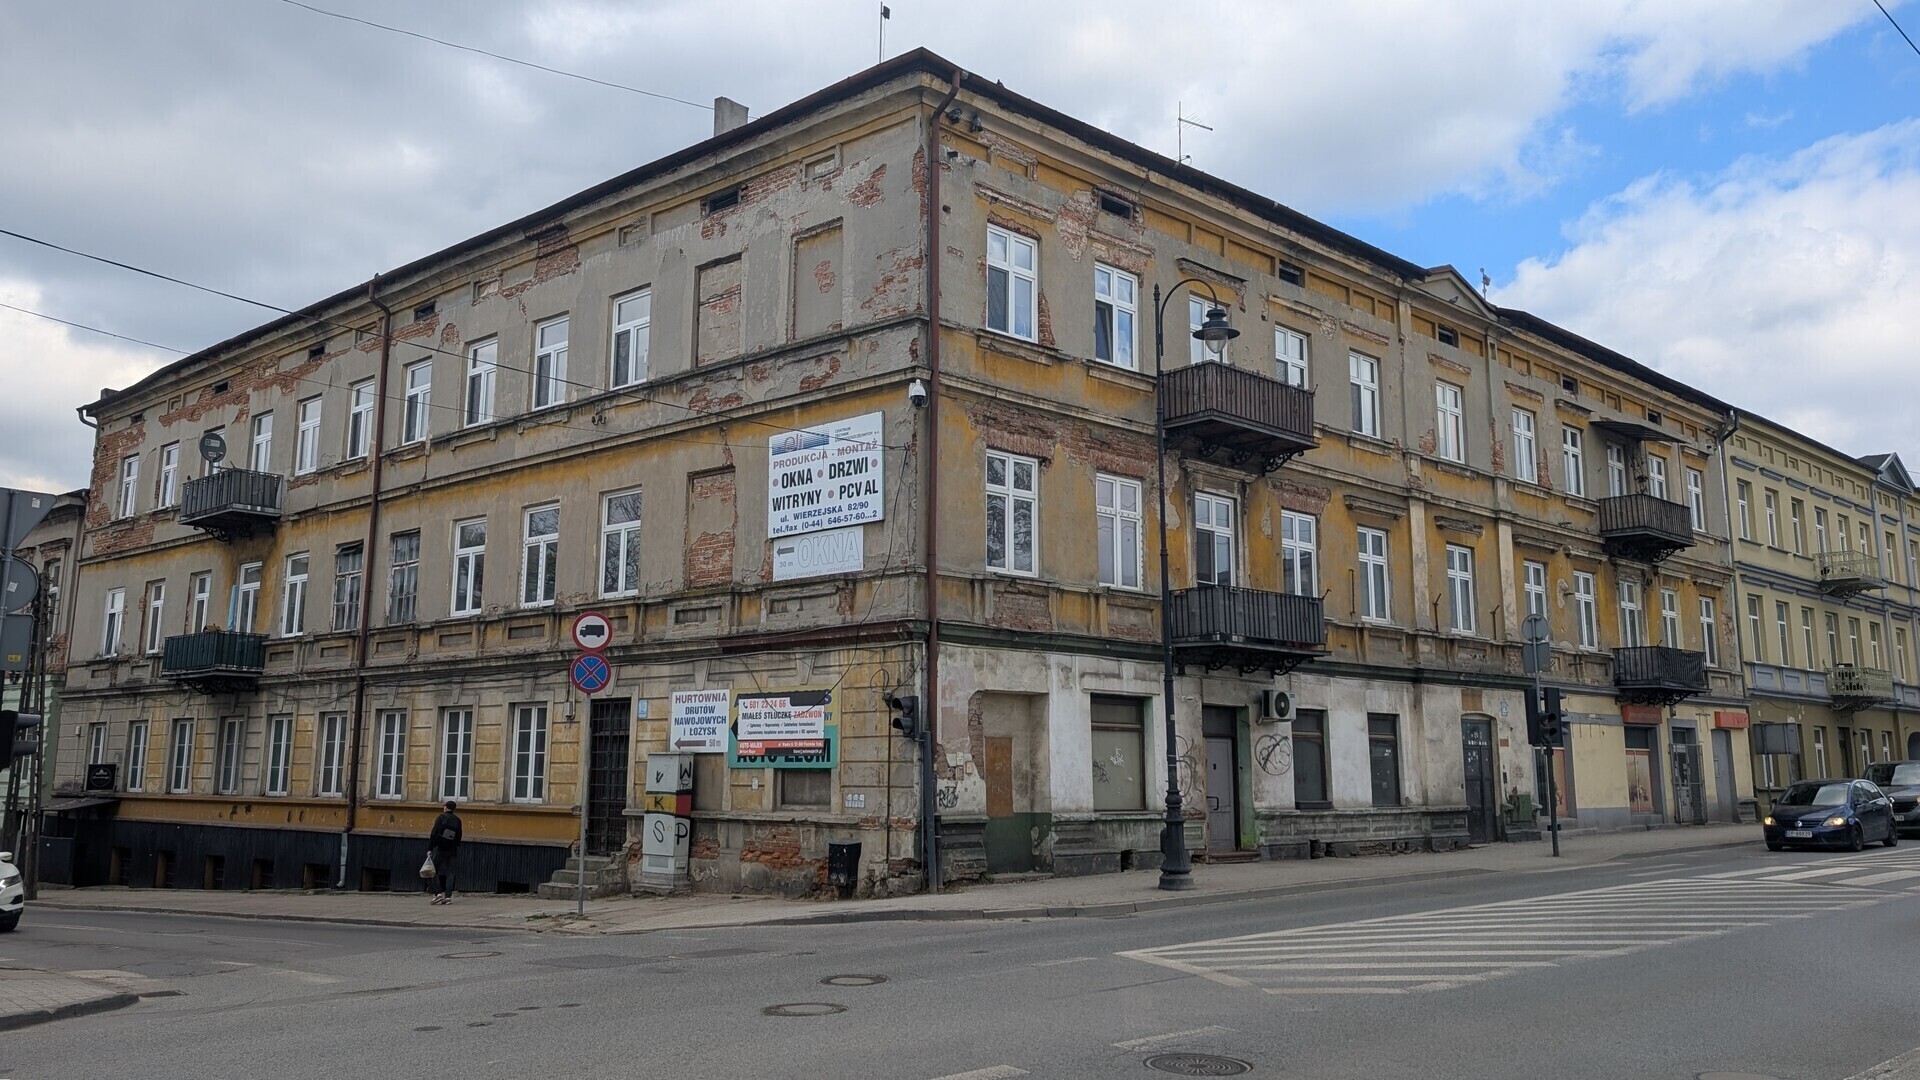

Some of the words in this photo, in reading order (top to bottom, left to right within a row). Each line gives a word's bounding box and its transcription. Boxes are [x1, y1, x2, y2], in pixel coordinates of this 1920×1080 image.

[773, 451, 828, 469] PRODUKCJA
[837, 438, 878, 457] MONTAŻ
[781, 468, 813, 490] OKNA
[828, 457, 869, 480] DRZWI
[772, 489, 822, 512] WITRYNY
[839, 483, 862, 500] PCV
[865, 479, 879, 496] AL
[780, 514, 790, 523] ul.
[793, 506, 843, 521] WIERZEJSKA
[847, 501, 869, 512] 82/90
[801, 519, 823, 531] (0-44)
[797, 530, 860, 568] OKNA
[675, 692, 727, 704] HURTOWNIA
[770, 700, 778, 708] 24
[779, 700, 786, 708] 66
[685, 704, 716, 715] DRUTÓW
[742, 710, 762, 720] MIAŁEŚ
[764, 710, 792, 720] STŁUCZKĘ
[794, 708, 822, 718] ZADZWOŃ
[674, 716, 727, 726] NAWOJOWYCH
[689, 725, 717, 737] ŁOŻYSK
[654, 796, 664, 810] K
[652, 820, 665, 843] S
[675, 822, 688, 845] P
